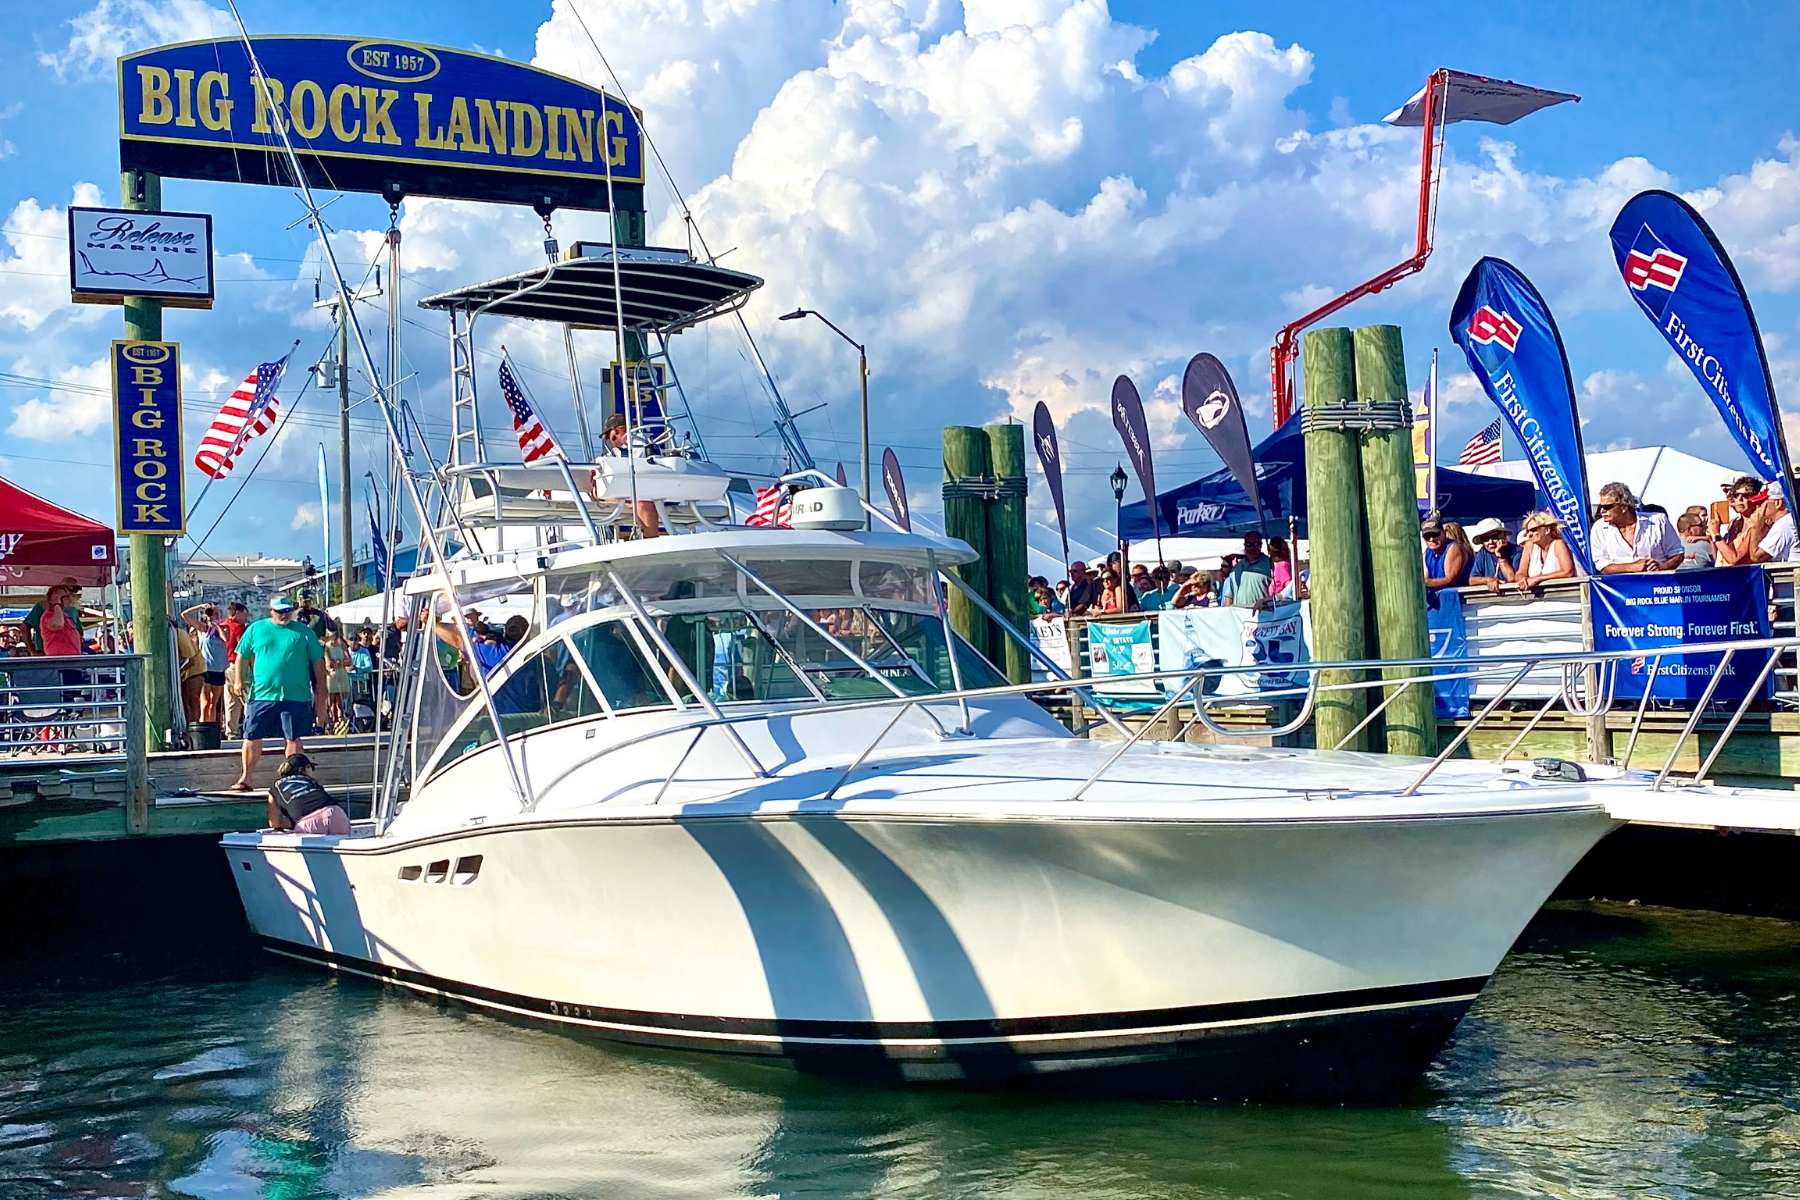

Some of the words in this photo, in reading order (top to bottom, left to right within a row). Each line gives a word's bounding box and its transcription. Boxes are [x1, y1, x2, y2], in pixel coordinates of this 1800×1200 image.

[362, 50, 390, 68] EST
[395, 54, 425, 72] 1957
[137, 65, 235, 132] BIG
[250, 75, 402, 147] ROCK
[413, 92, 628, 167] LANDING
[89, 216, 195, 246] Release
[87, 242, 198, 254] MARINE
[130, 366, 165, 428] BIG
[132, 438, 171, 522] ROCK
[1625, 598, 1637, 606] BIG
[1637, 597, 1653, 606] ROCK
[1654, 596, 1669, 605] BLUE
[1669, 595, 1691, 604] MARLIN
[1692, 593, 1731, 603] TOURNAMENT
[1653, 586, 1673, 595] PROUD
[1674, 585, 1702, 594] SPONSOR
[1605, 624, 1645, 638] Forever
[1647, 623, 1686, 640] Strong.
[1688, 622, 1728, 636] Forever
[1646, 663, 1736, 677] FrstCitizensBnk
